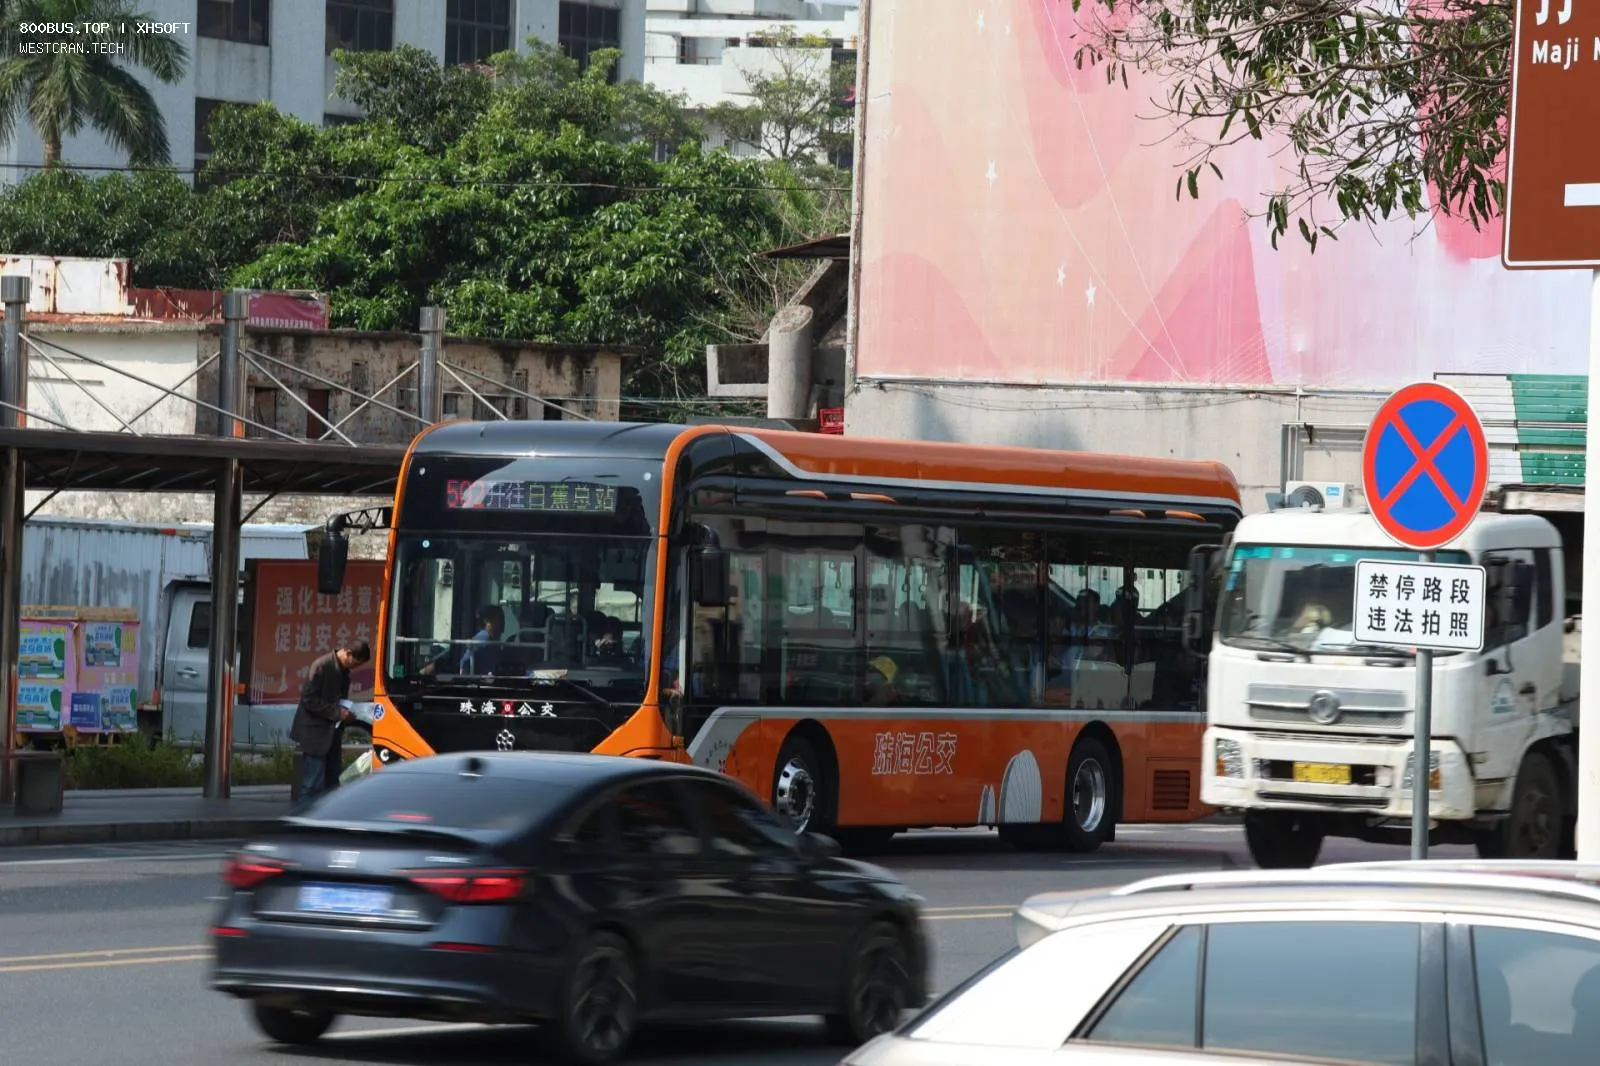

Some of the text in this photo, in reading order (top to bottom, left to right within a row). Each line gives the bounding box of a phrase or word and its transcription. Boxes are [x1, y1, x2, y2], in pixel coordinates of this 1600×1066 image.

[1532, 37, 1580, 70] Maji
[1369, 573, 1470, 604] 禁停路段
[1367, 606, 1469, 637] 违法拍照
[872, 732, 958, 775] 珠海公交
